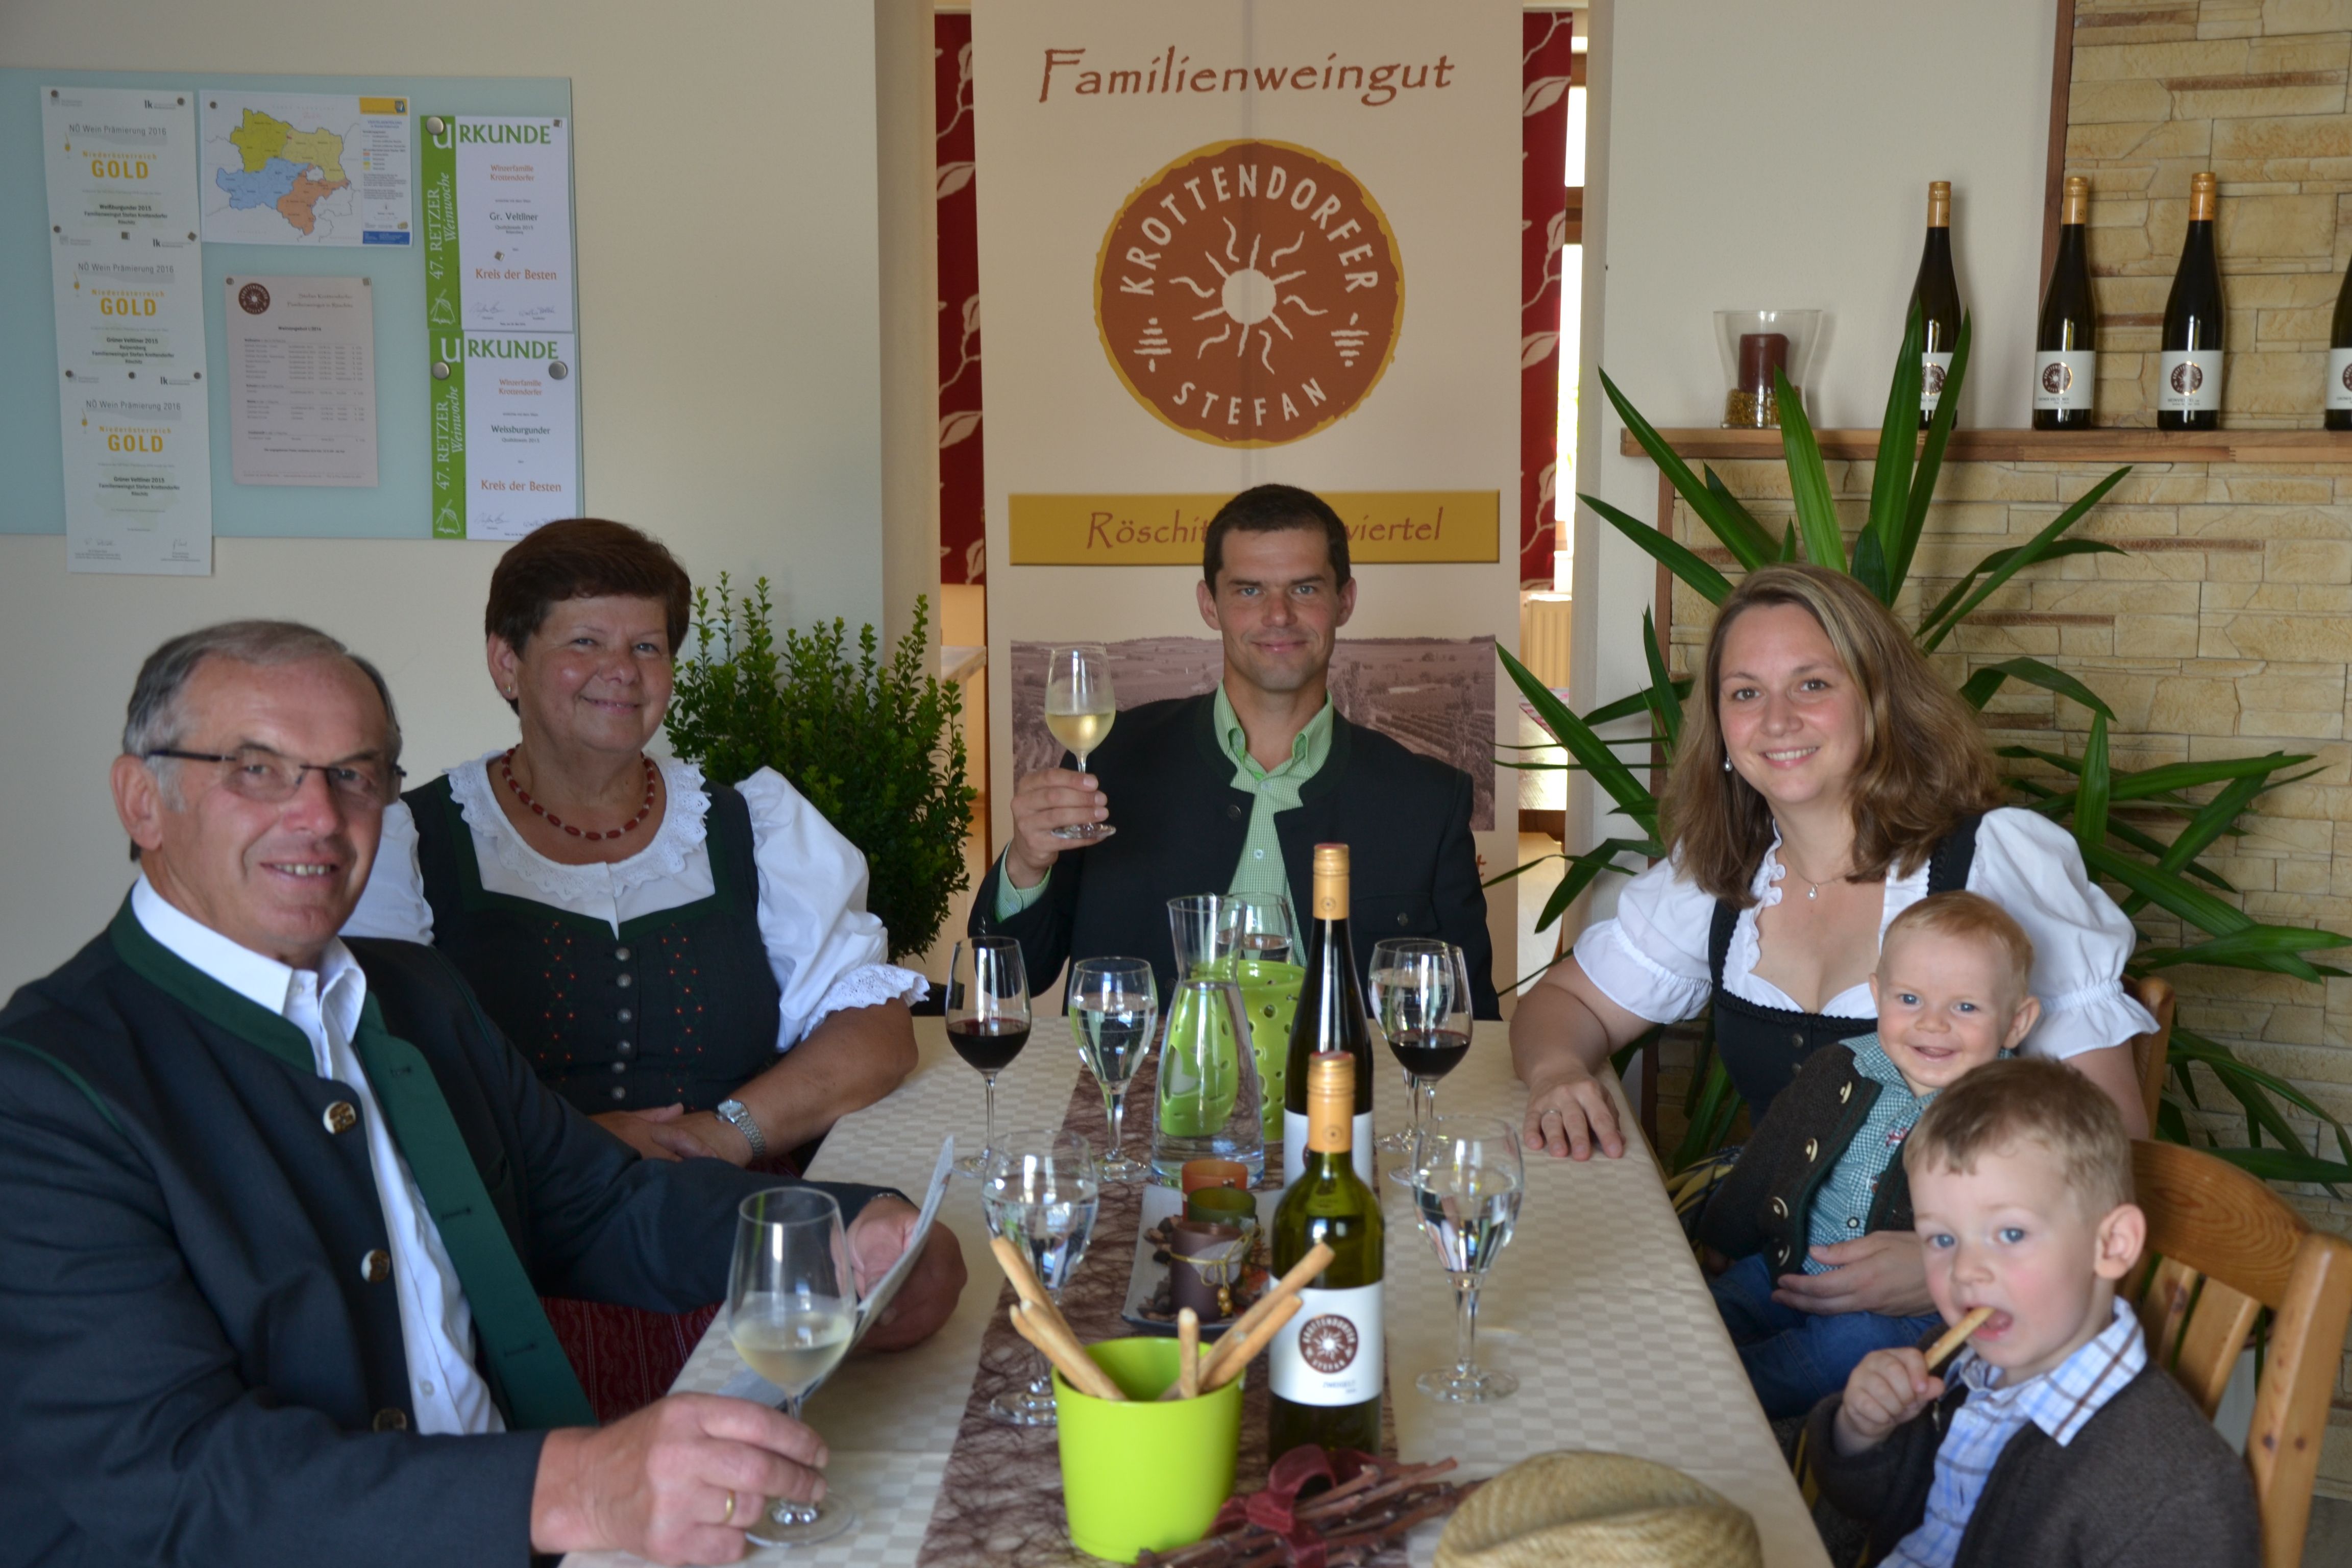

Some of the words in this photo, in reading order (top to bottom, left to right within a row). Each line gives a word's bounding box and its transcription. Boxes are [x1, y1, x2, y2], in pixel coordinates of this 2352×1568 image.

[1039, 45, 1455, 107] Familienweingut
[69, 123, 80, 133] NÖ
[83, 125, 102, 133] Wein
[104, 125, 146, 137] Prämierung
[148, 127, 167, 136] 2016
[432, 123, 552, 150] URKUNDE
[91, 159, 149, 179] GOLD
[490, 174, 535, 182] Krottendorfer
[436, 172, 457, 242] Weinwoche
[427, 187, 443, 252] RETZER
[489, 212, 503, 221] Gr.
[505, 212, 538, 222] Veltliner
[1120, 164, 1379, 297] KROTTENDORFER
[78, 261, 89, 272] NÖ
[91, 263, 111, 272] Wein
[113, 264, 154, 275] Prämierung
[156, 265, 174, 274] 2016
[475, 268, 501, 280] Kreis
[504, 269, 521, 280] der
[525, 270, 557, 280] Besten
[100, 297, 157, 316] GOLD
[440, 337, 559, 363] URKUNDE
[498, 387, 543, 396] Krottendorfer
[499, 379, 542, 387] Winzerfamilie
[86, 399, 97, 409] NÖ
[120, 401, 161, 412] Prämierung
[163, 403, 181, 411] 2016
[1172, 377, 1328, 427] STEFAN
[446, 385, 463, 453] Weinwoche
[436, 401, 450, 462] RETZER
[491, 425, 551, 435] Weissburgunder
[107, 434, 164, 453] GOLD
[481, 480, 506, 491] Kreis
[509, 481, 526, 491] der
[529, 481, 561, 492] Besten
[1086, 509, 1208, 550] Röschit
[1345, 506, 1443, 541] viertel
